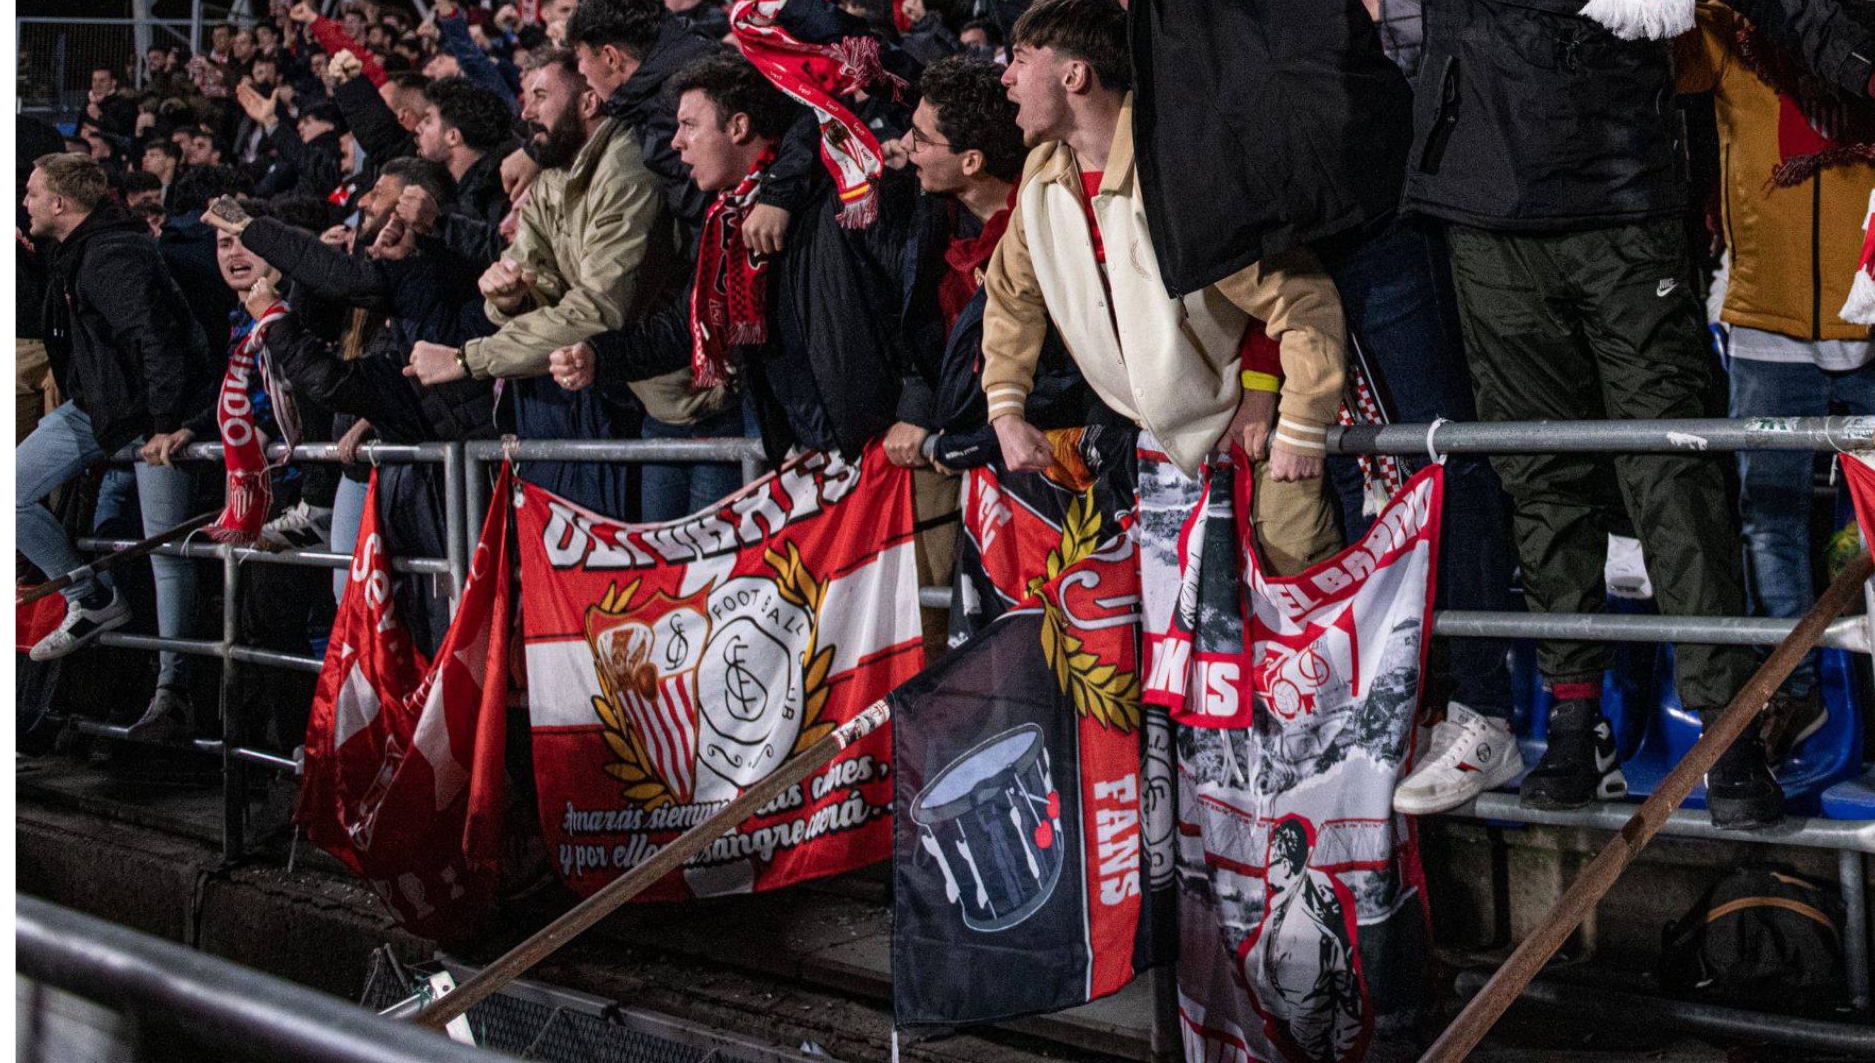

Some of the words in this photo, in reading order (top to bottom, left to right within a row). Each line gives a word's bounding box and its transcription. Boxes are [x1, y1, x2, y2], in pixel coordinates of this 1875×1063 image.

[711, 588, 806, 637] FOOTBALL
[575, 842, 609, 877] por
[612, 833, 670, 868] ello
[1092, 772, 1142, 910] FANS
